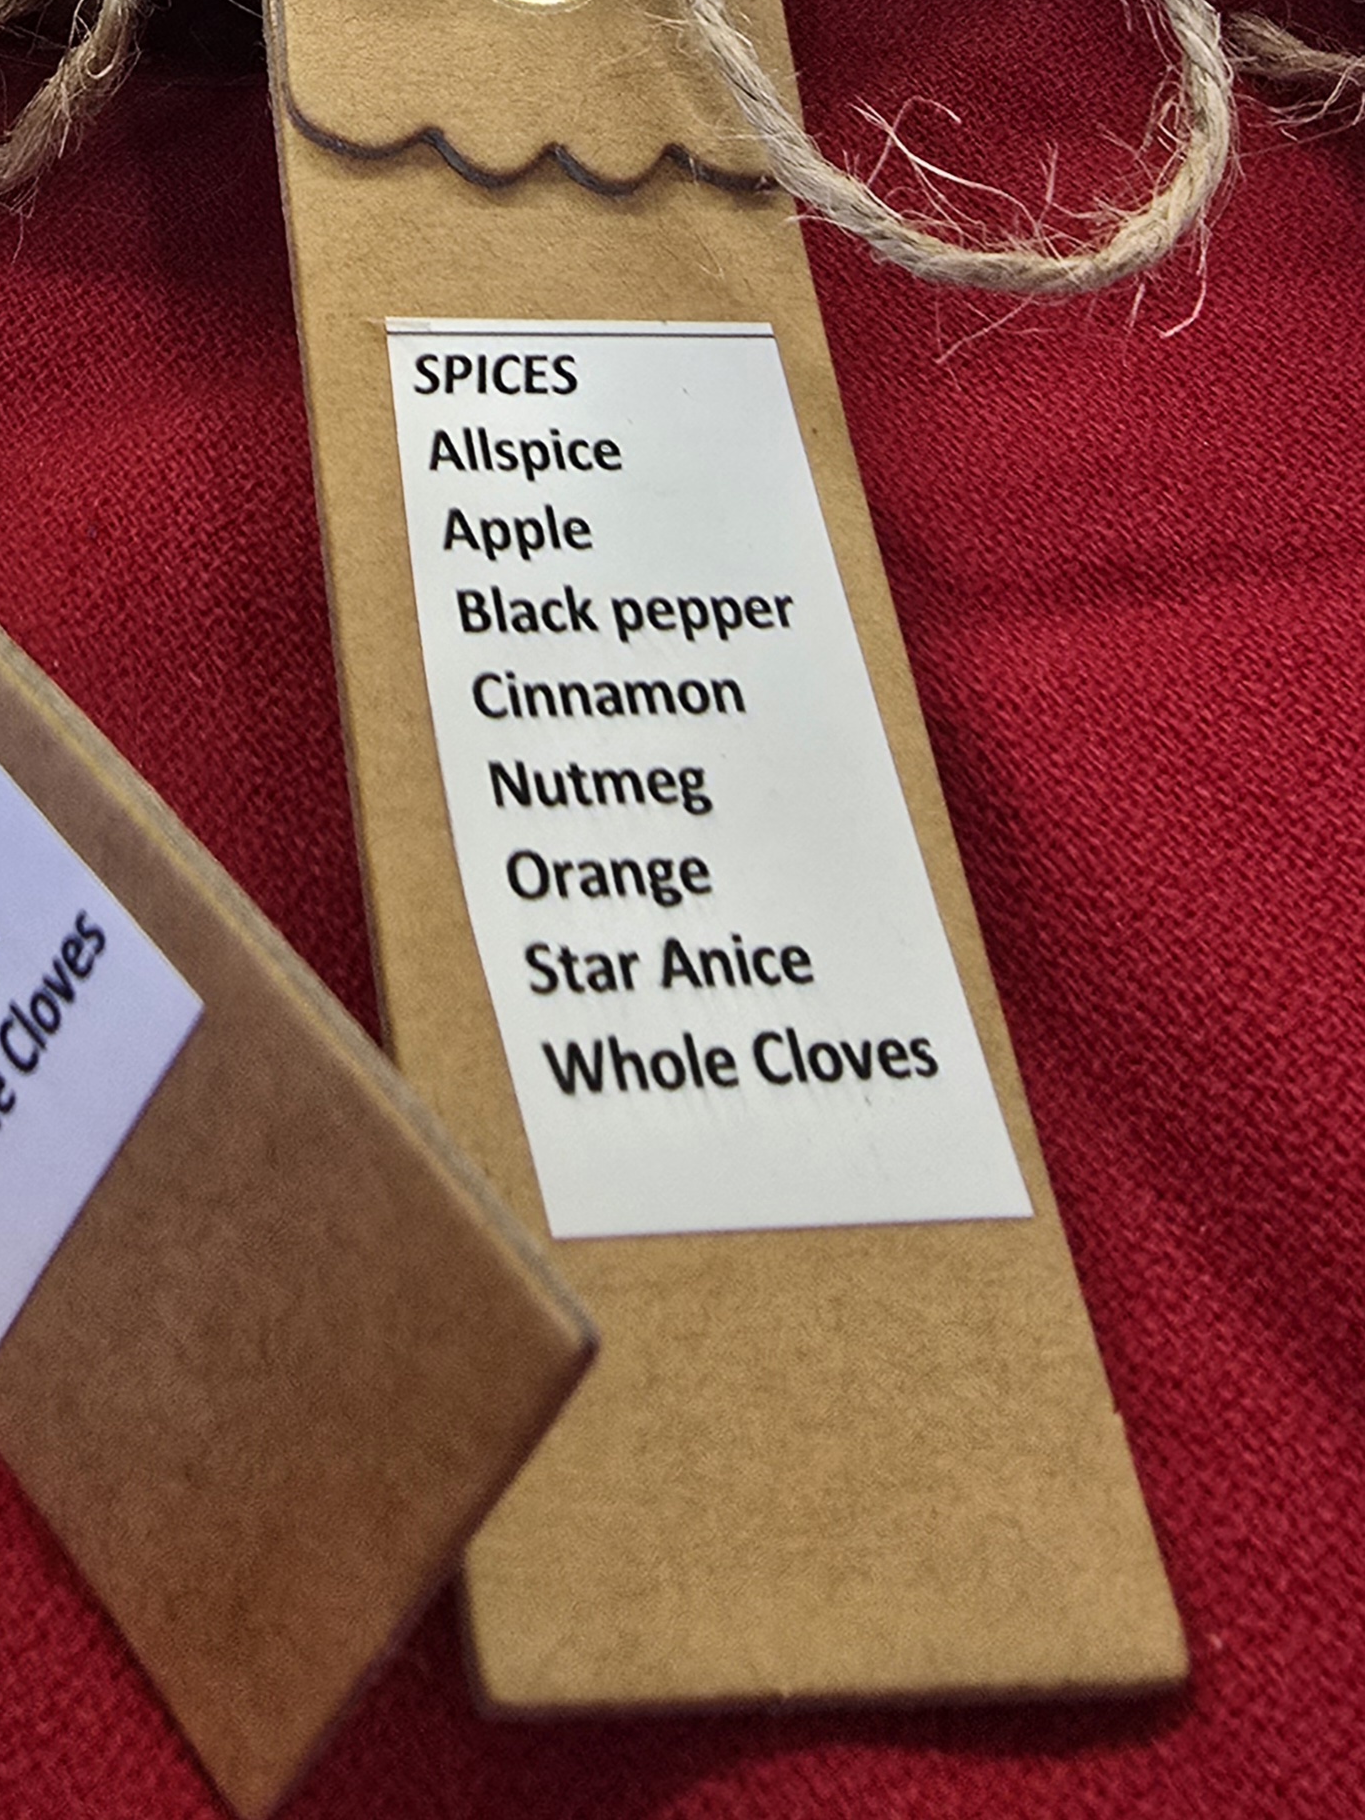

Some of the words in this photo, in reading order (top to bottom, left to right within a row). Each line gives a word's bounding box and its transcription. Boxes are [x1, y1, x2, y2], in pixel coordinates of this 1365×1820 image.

[414, 353, 578, 396] SPICES
[428, 427, 623, 482] Allspice
[443, 504, 593, 562] Apple
[456, 584, 598, 634] Black
[611, 591, 793, 644] pepper
[472, 670, 746, 720] Cinnamon
[488, 760, 714, 816] Nutmeg
[506, 849, 713, 909] Orange
[0, 909, 106, 1073] Cloves
[524, 942, 640, 996] Star
[660, 933, 814, 990] Anice
[541, 1031, 740, 1096] Whole
[753, 1027, 939, 1086] Cloves
